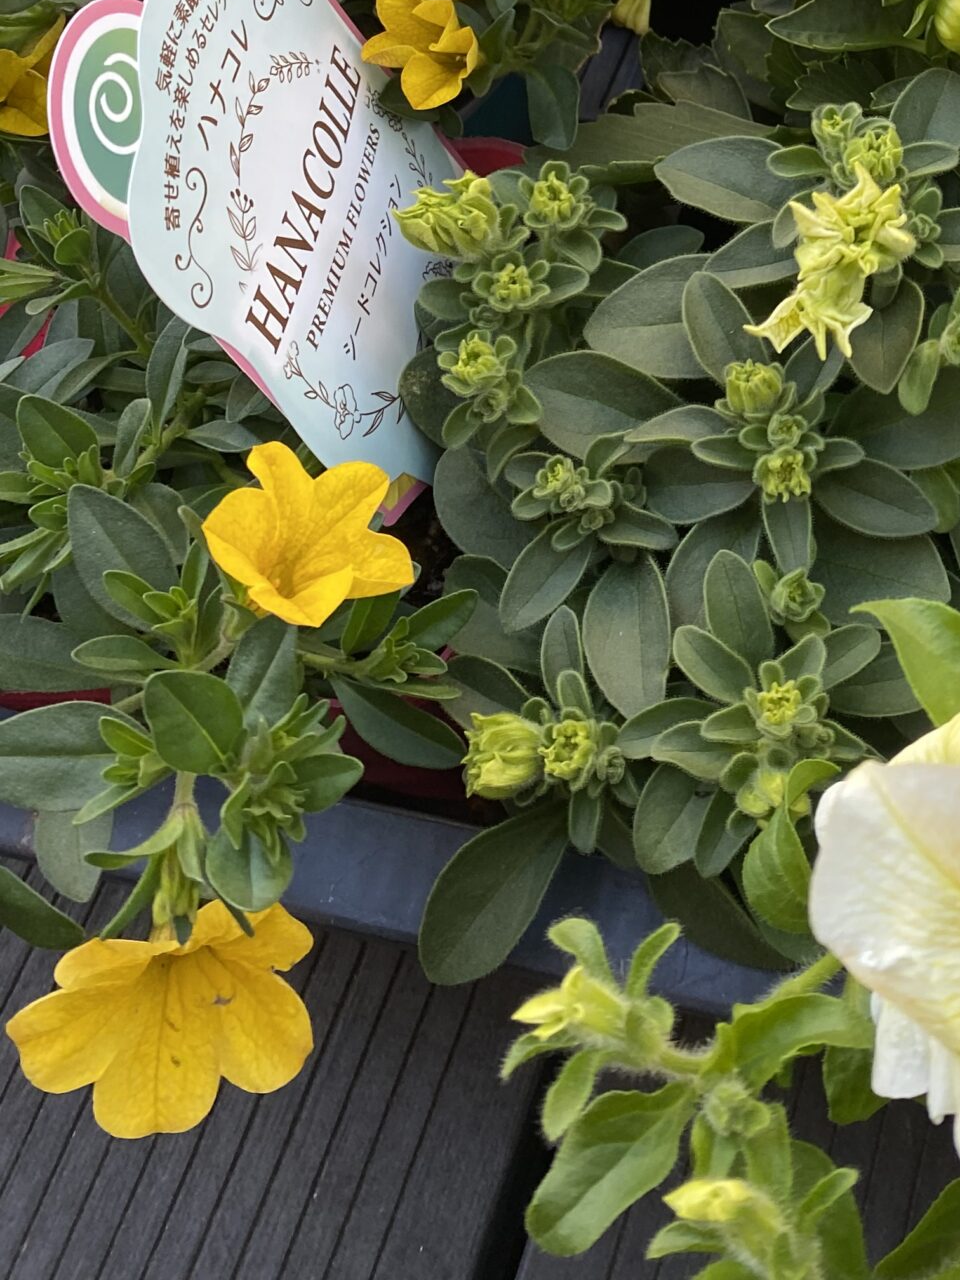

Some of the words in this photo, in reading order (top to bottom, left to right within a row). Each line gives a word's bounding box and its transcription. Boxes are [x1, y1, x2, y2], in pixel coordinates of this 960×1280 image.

[197, 19, 249, 152] ハナコレ
[245, 44, 362, 355] HANACOLLE
[305, 227, 354, 352] PREMIUM
[346, 122, 382, 235] FLOWERS
[343, 173, 404, 361] シードコレクション
